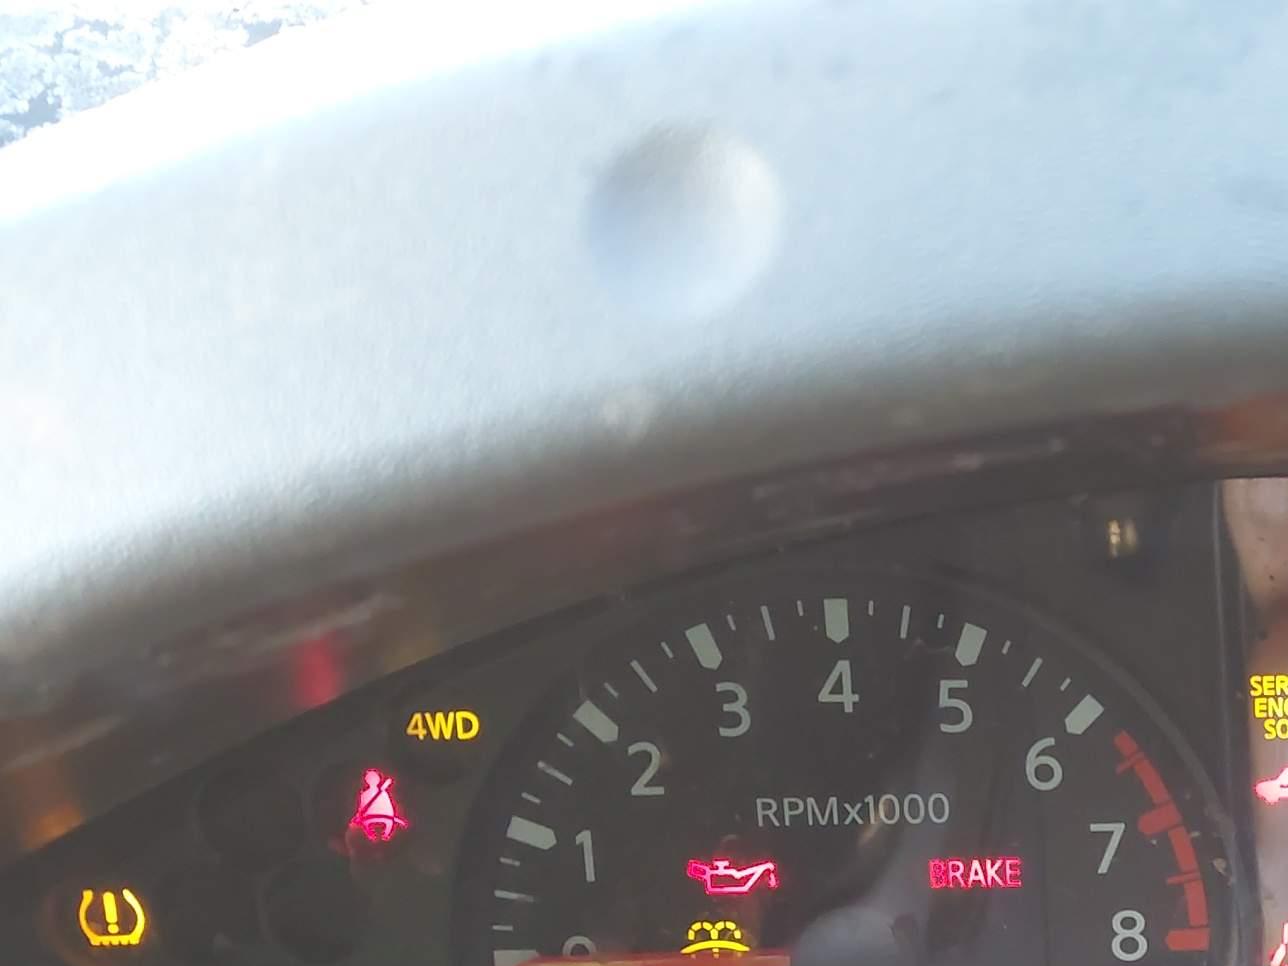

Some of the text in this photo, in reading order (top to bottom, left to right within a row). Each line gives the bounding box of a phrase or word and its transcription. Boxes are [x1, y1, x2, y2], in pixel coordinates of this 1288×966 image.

[715, 681, 752, 738] 3
[817, 659, 861, 714] 4
[937, 679, 975, 734] 5
[406, 710, 480, 741] 4WD
[627, 741, 666, 797] 2
[1025, 737, 1064, 792] 6
[755, 792, 951, 828] RPMx1000
[574, 829, 596, 883] 1
[929, 857, 1023, 889] BRAKE
[1089, 821, 1126, 875] 7
[1110, 909, 1150, 962] 8
